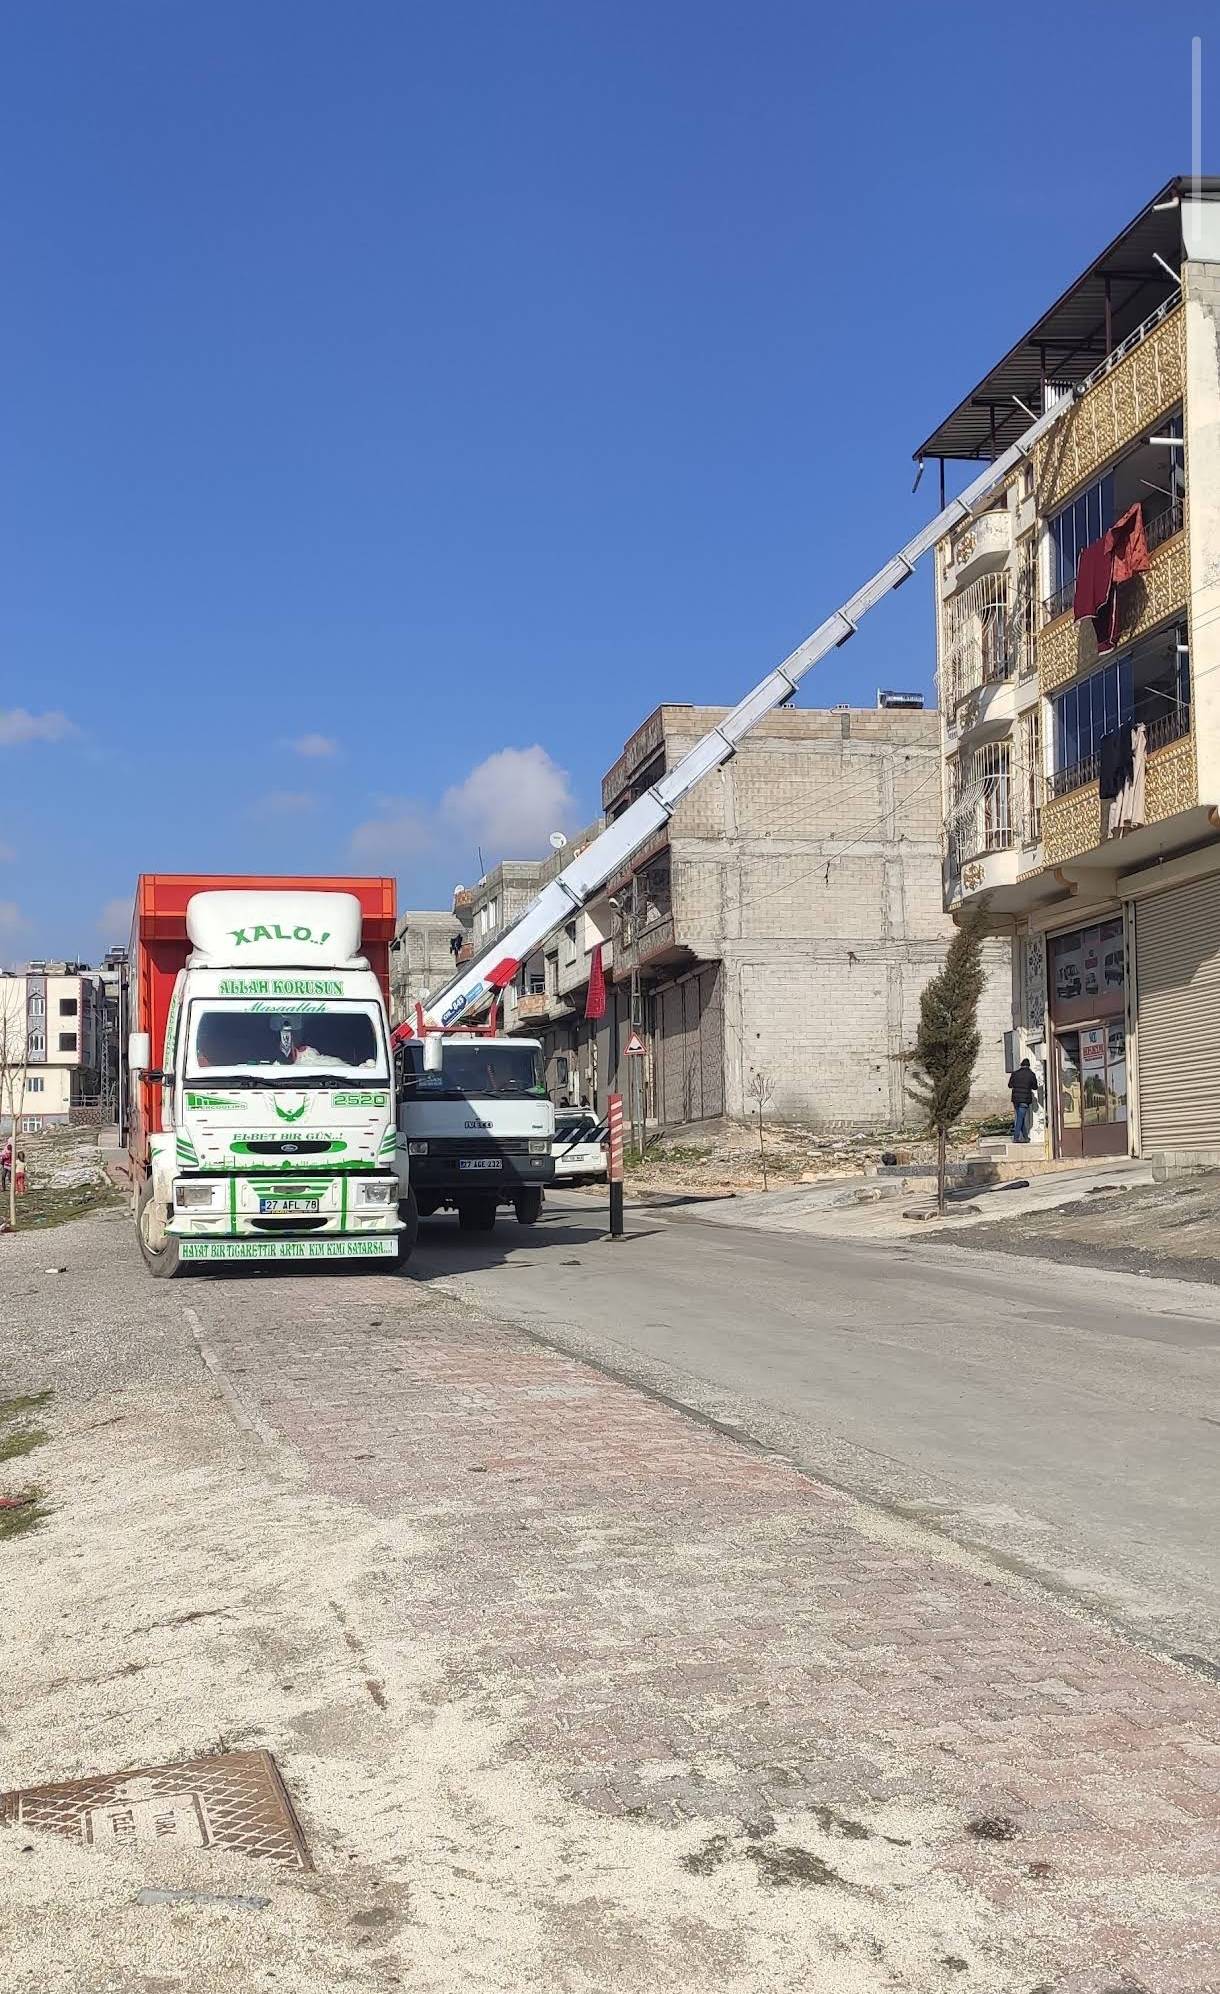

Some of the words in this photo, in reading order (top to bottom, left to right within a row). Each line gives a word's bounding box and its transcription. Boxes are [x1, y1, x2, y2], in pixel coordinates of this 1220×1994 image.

[219, 980, 269, 995] ALLAH
[272, 980, 344, 996] KORUSUN
[334, 1095, 386, 1106] 2520
[233, 1133, 277, 1141] ELBET
[266, 1200, 278, 1210] 27
[282, 1200, 300, 1210] AFL
[304, 1200, 317, 1209] 78
[182, 1244, 209, 1258] HAYAT
[279, 1243, 305, 1257] ARTIK
